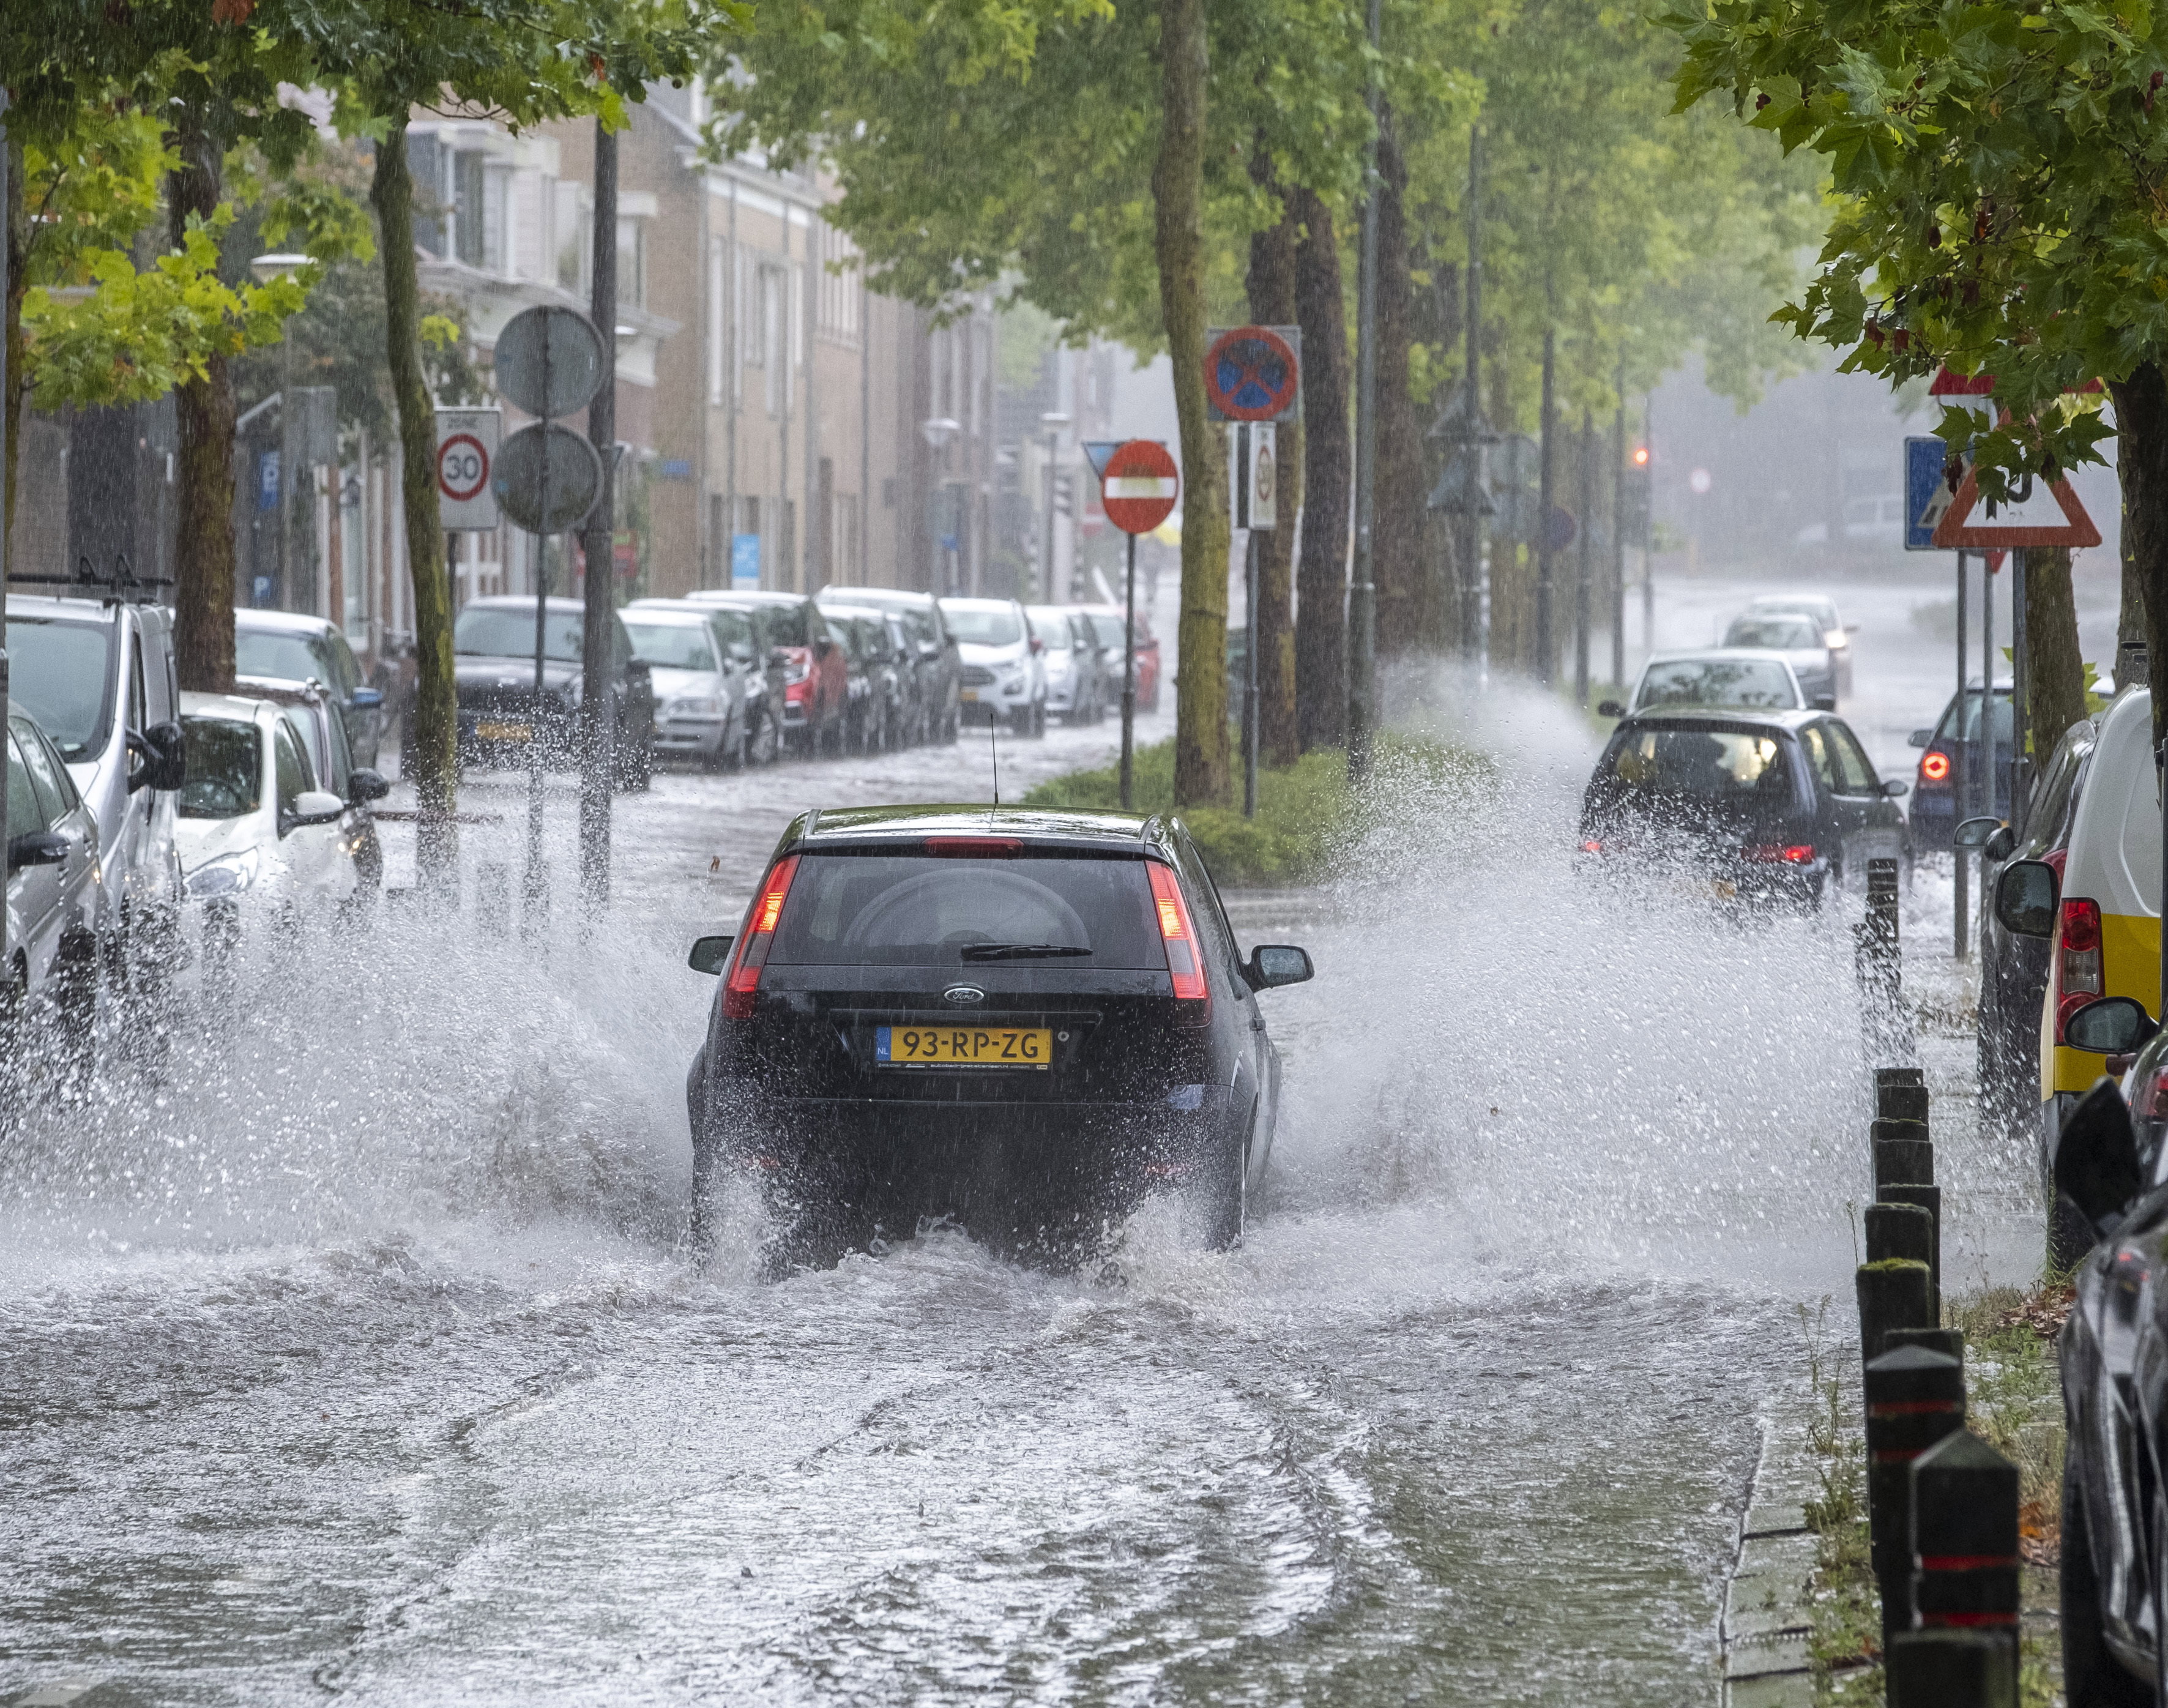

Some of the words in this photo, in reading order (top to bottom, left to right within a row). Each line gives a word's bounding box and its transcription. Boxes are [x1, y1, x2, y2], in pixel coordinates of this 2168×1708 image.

[446, 455, 479, 479] 30
[953, 991, 975, 999] Ford
[903, 1031, 1038, 1059] 93-RP-ZG
